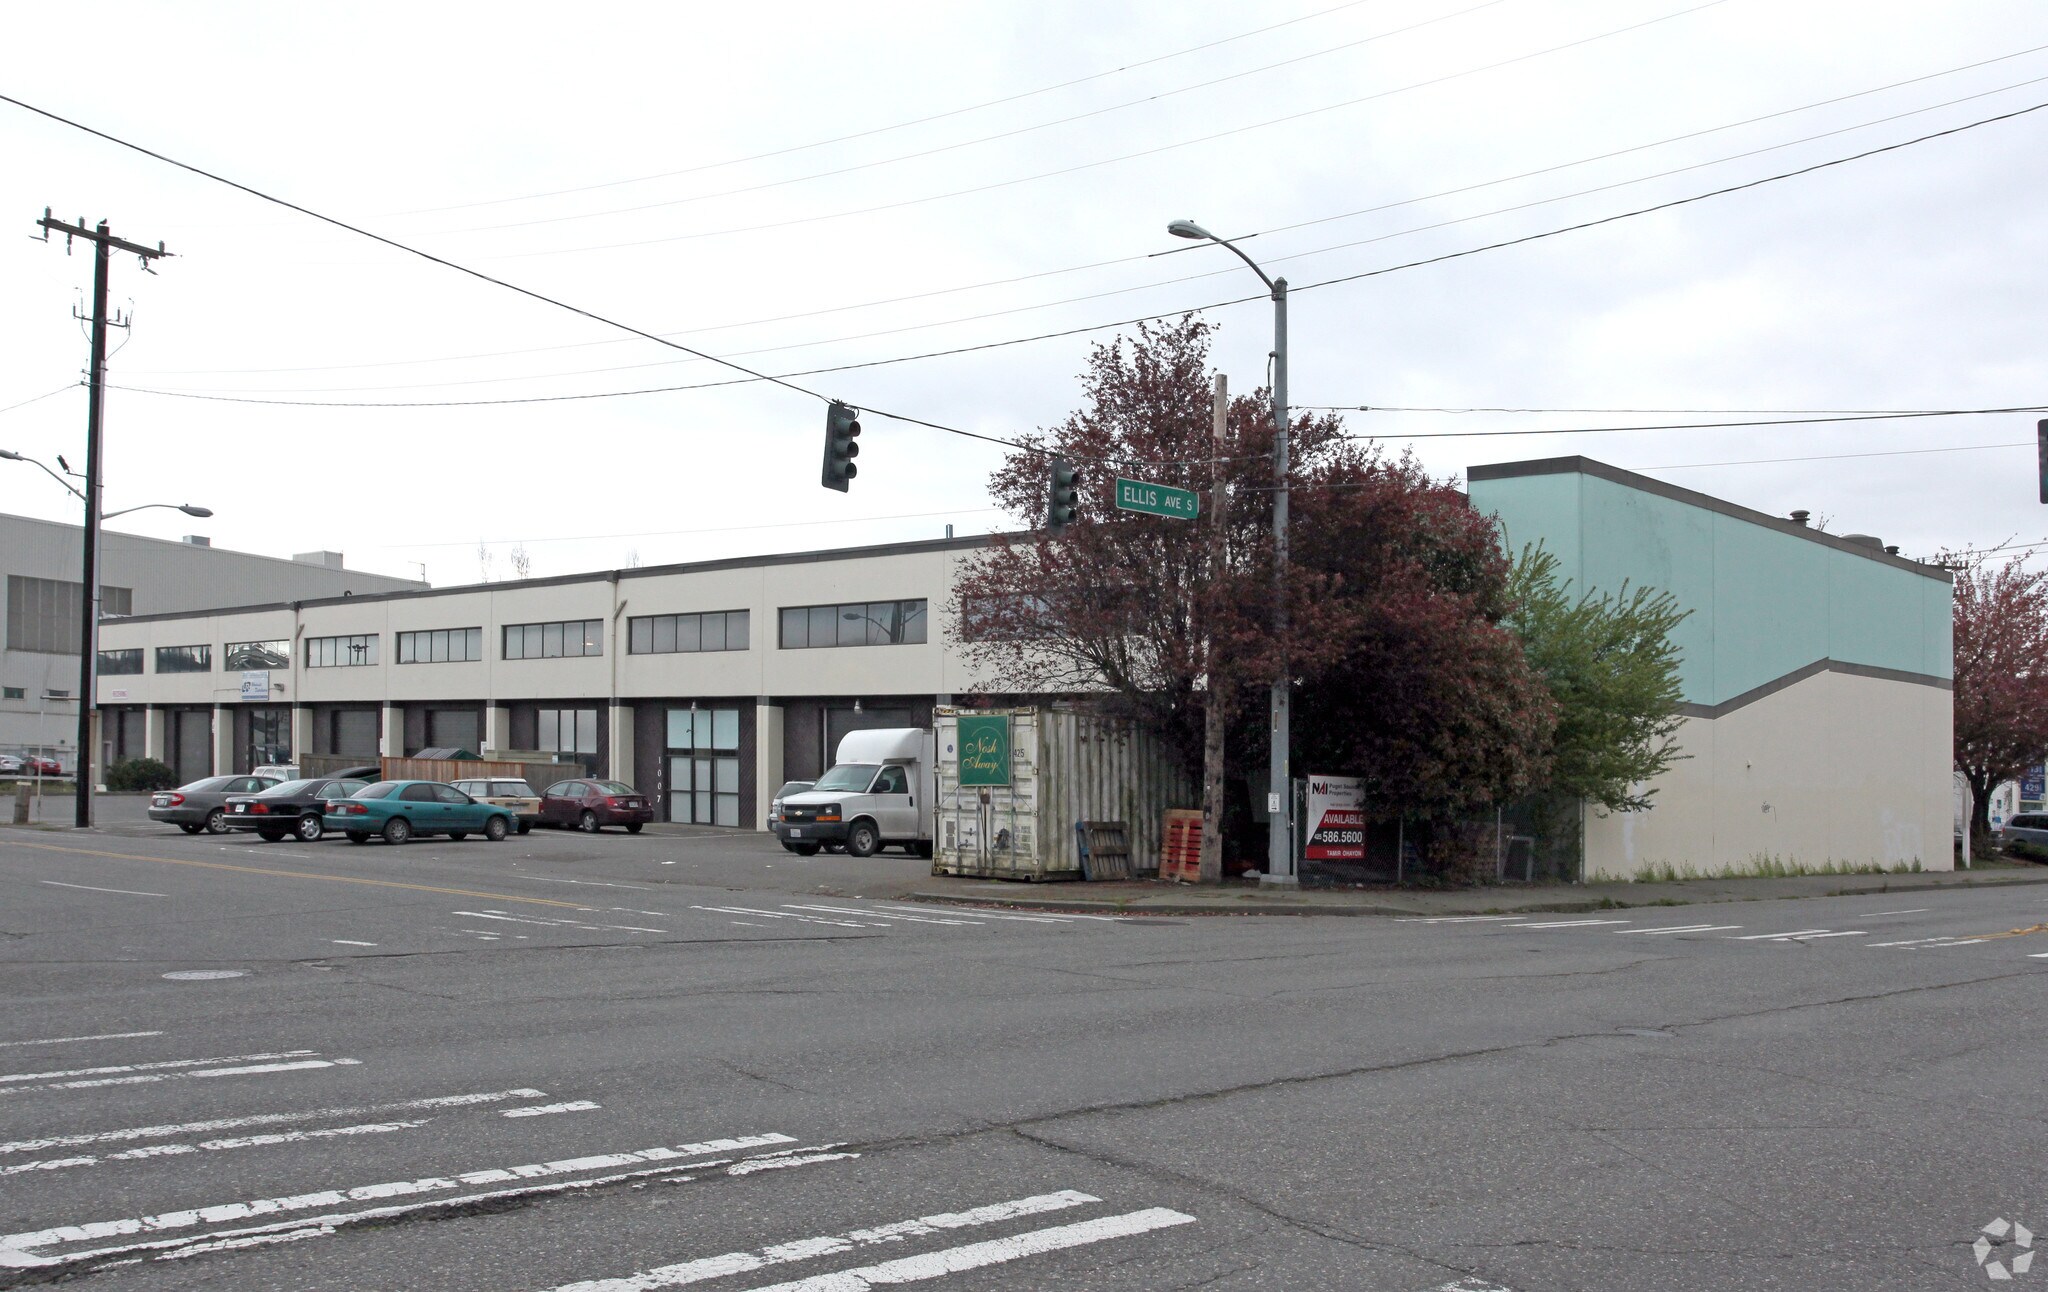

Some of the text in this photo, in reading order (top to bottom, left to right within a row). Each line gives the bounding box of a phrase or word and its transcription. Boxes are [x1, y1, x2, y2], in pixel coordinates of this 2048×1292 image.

[1123, 486, 1193, 511] ELLIS AVE S
[965, 736, 997, 754] Nosh
[962, 751, 999, 775] Away
[1312, 781, 1328, 795] NAI
[1323, 814, 1364, 824] AVAILABLE
[1322, 830, 1363, 843] 586.5600
